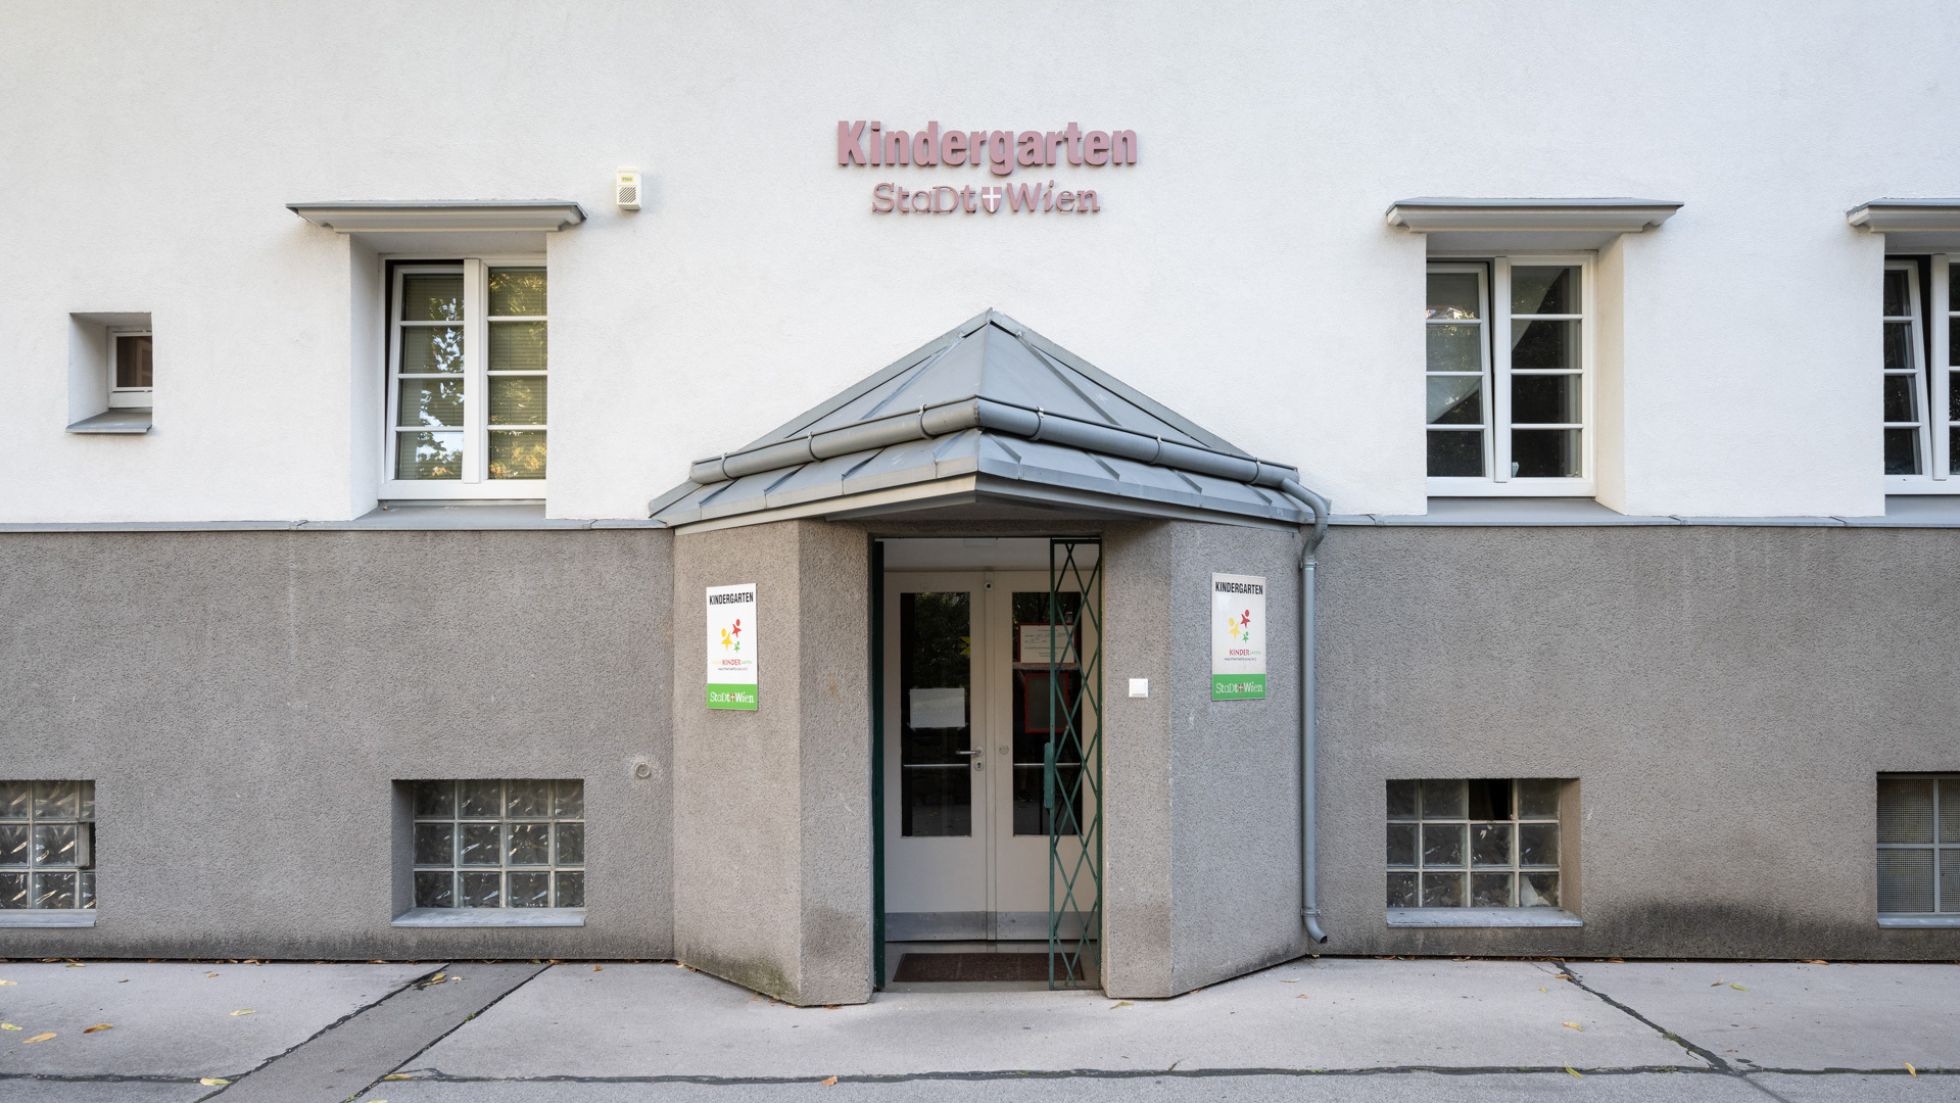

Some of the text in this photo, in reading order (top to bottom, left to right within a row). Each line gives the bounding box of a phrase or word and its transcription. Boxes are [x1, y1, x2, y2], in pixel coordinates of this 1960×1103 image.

[838, 120, 1138, 176] Kindergarten
[1006, 179, 1100, 213] Wien
[1215, 582, 1263, 595] KINDERGARTEN
[709, 592, 754, 605] KINDERGARTEN
[1243, 681, 1263, 693] Wien
[736, 691, 754, 704] Wien
